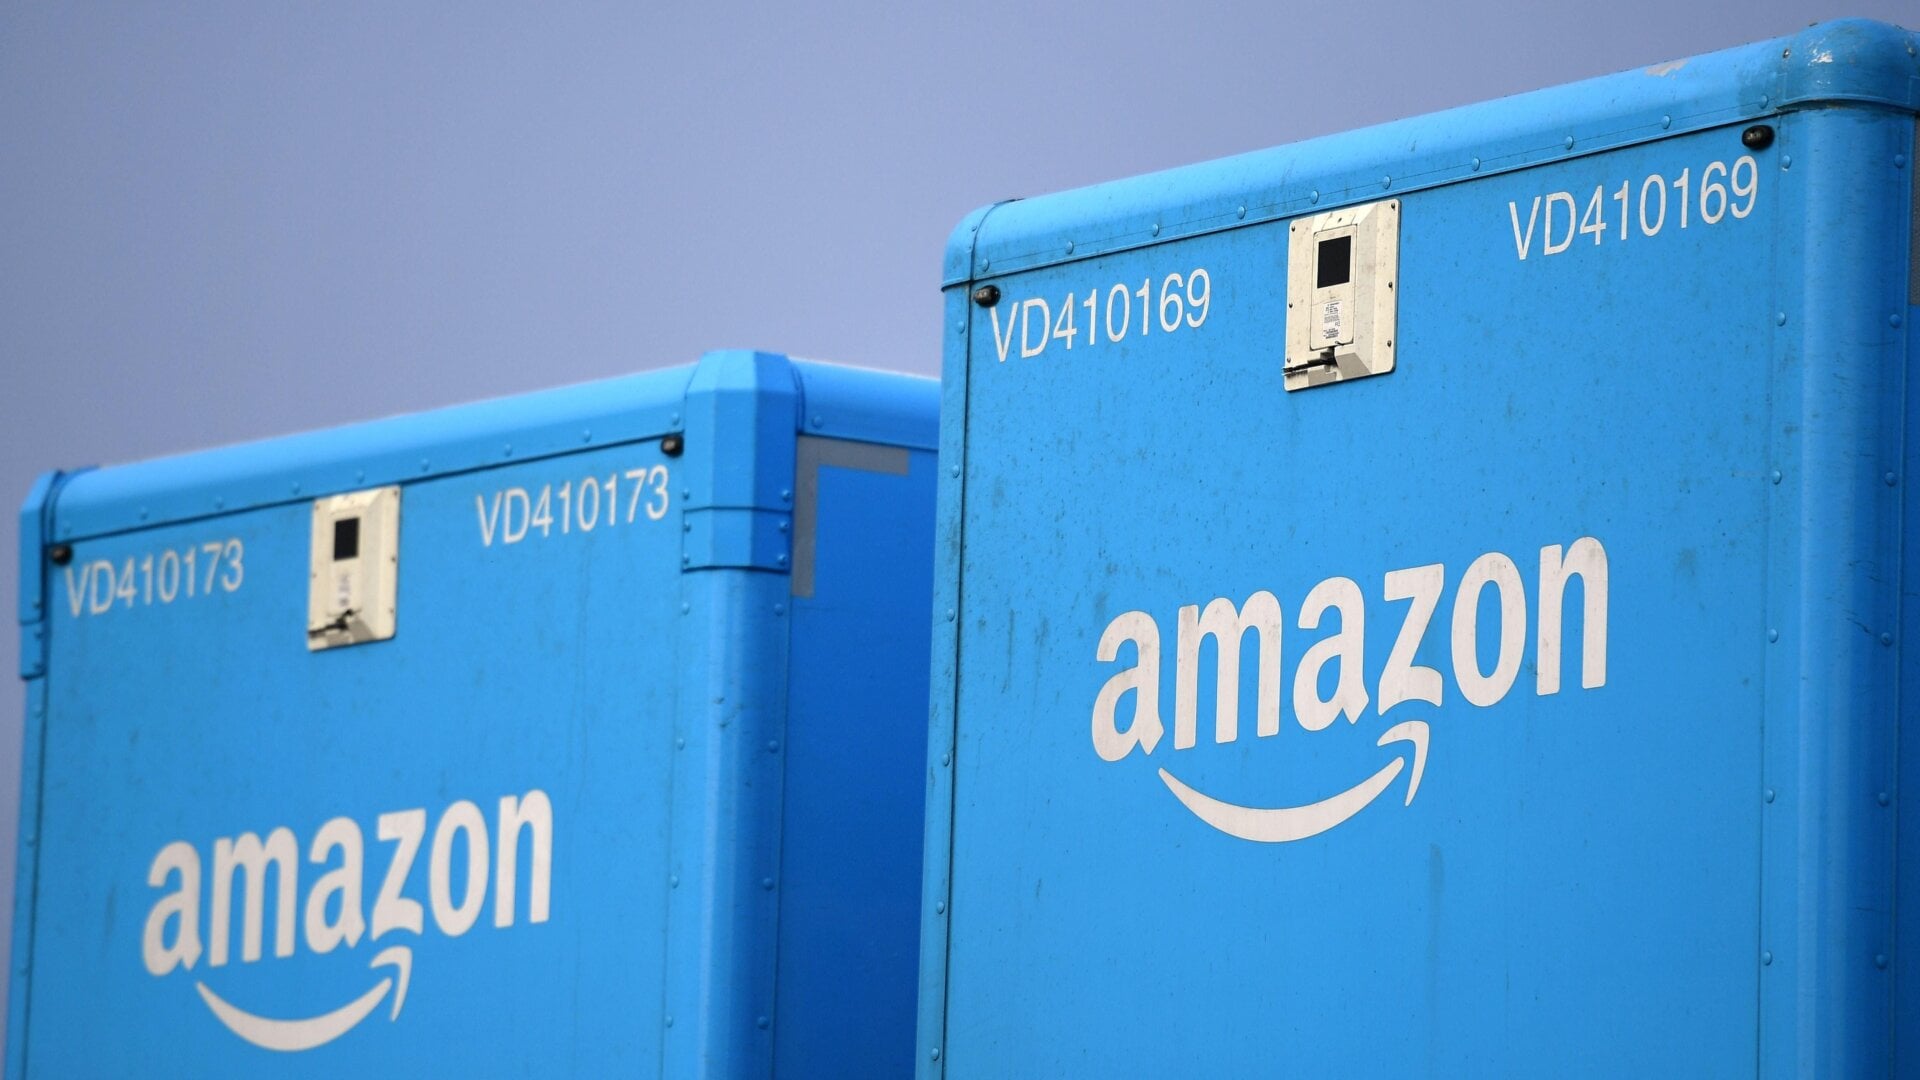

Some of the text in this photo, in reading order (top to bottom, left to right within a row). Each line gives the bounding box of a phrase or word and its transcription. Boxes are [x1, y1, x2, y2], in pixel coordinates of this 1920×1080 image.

[1509, 156, 1758, 261] VD410169
[989, 267, 1211, 363] VD410169
[475, 463, 671, 547] VD410173
[66, 538, 244, 617] VD410173
[1091, 536, 1609, 762] amazon
[142, 789, 553, 977] amazon
